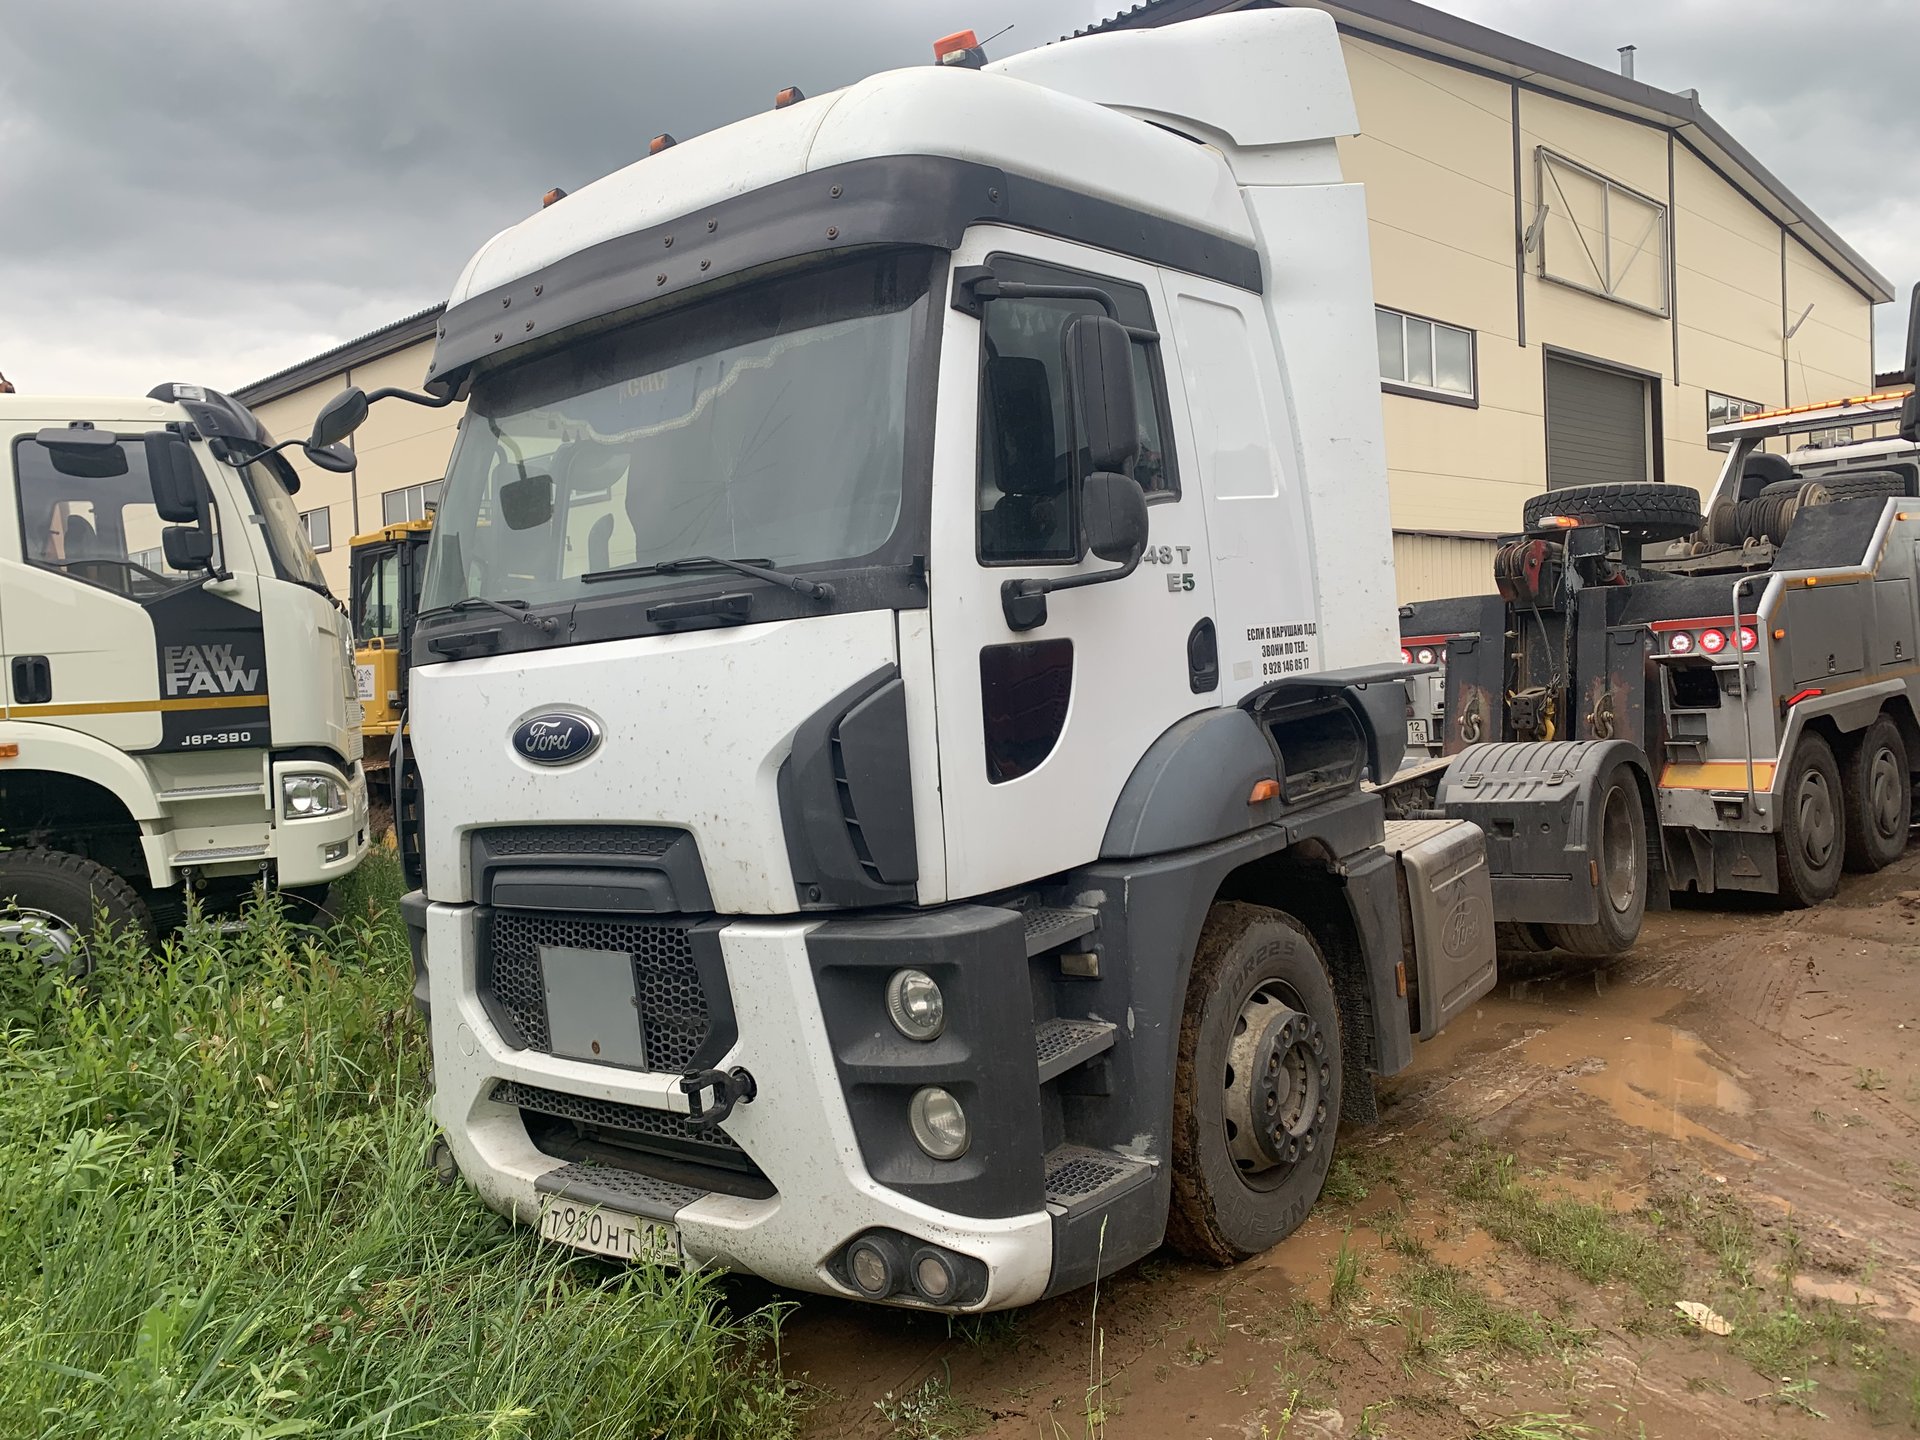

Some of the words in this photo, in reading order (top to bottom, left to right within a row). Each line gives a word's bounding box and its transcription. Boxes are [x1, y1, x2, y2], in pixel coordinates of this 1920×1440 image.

[1167, 573, 1195, 592] E5
[1247, 627, 1265, 641] ЕСЛИ
[1266, 627, 1271, 639] Я
[1272, 624, 1303, 638] НАРУШАЮ
[1304, 622, 1317, 636] ПДД
[1262, 643, 1284, 658] ЗВОНИ
[1285, 642, 1294, 655] ПО
[1263, 663, 1268, 675] 8
[1269, 661, 1282, 675] 928
[1282, 659, 1294, 672] 146
[1303, 657, 1309, 669] 17
[166, 669, 259, 695] FAW
[181, 732, 251, 746] J6P-390
[525, 721, 573, 752] Ford
[1415, 733, 1425, 741] 18
[645, 1224, 669, 1250] 1
